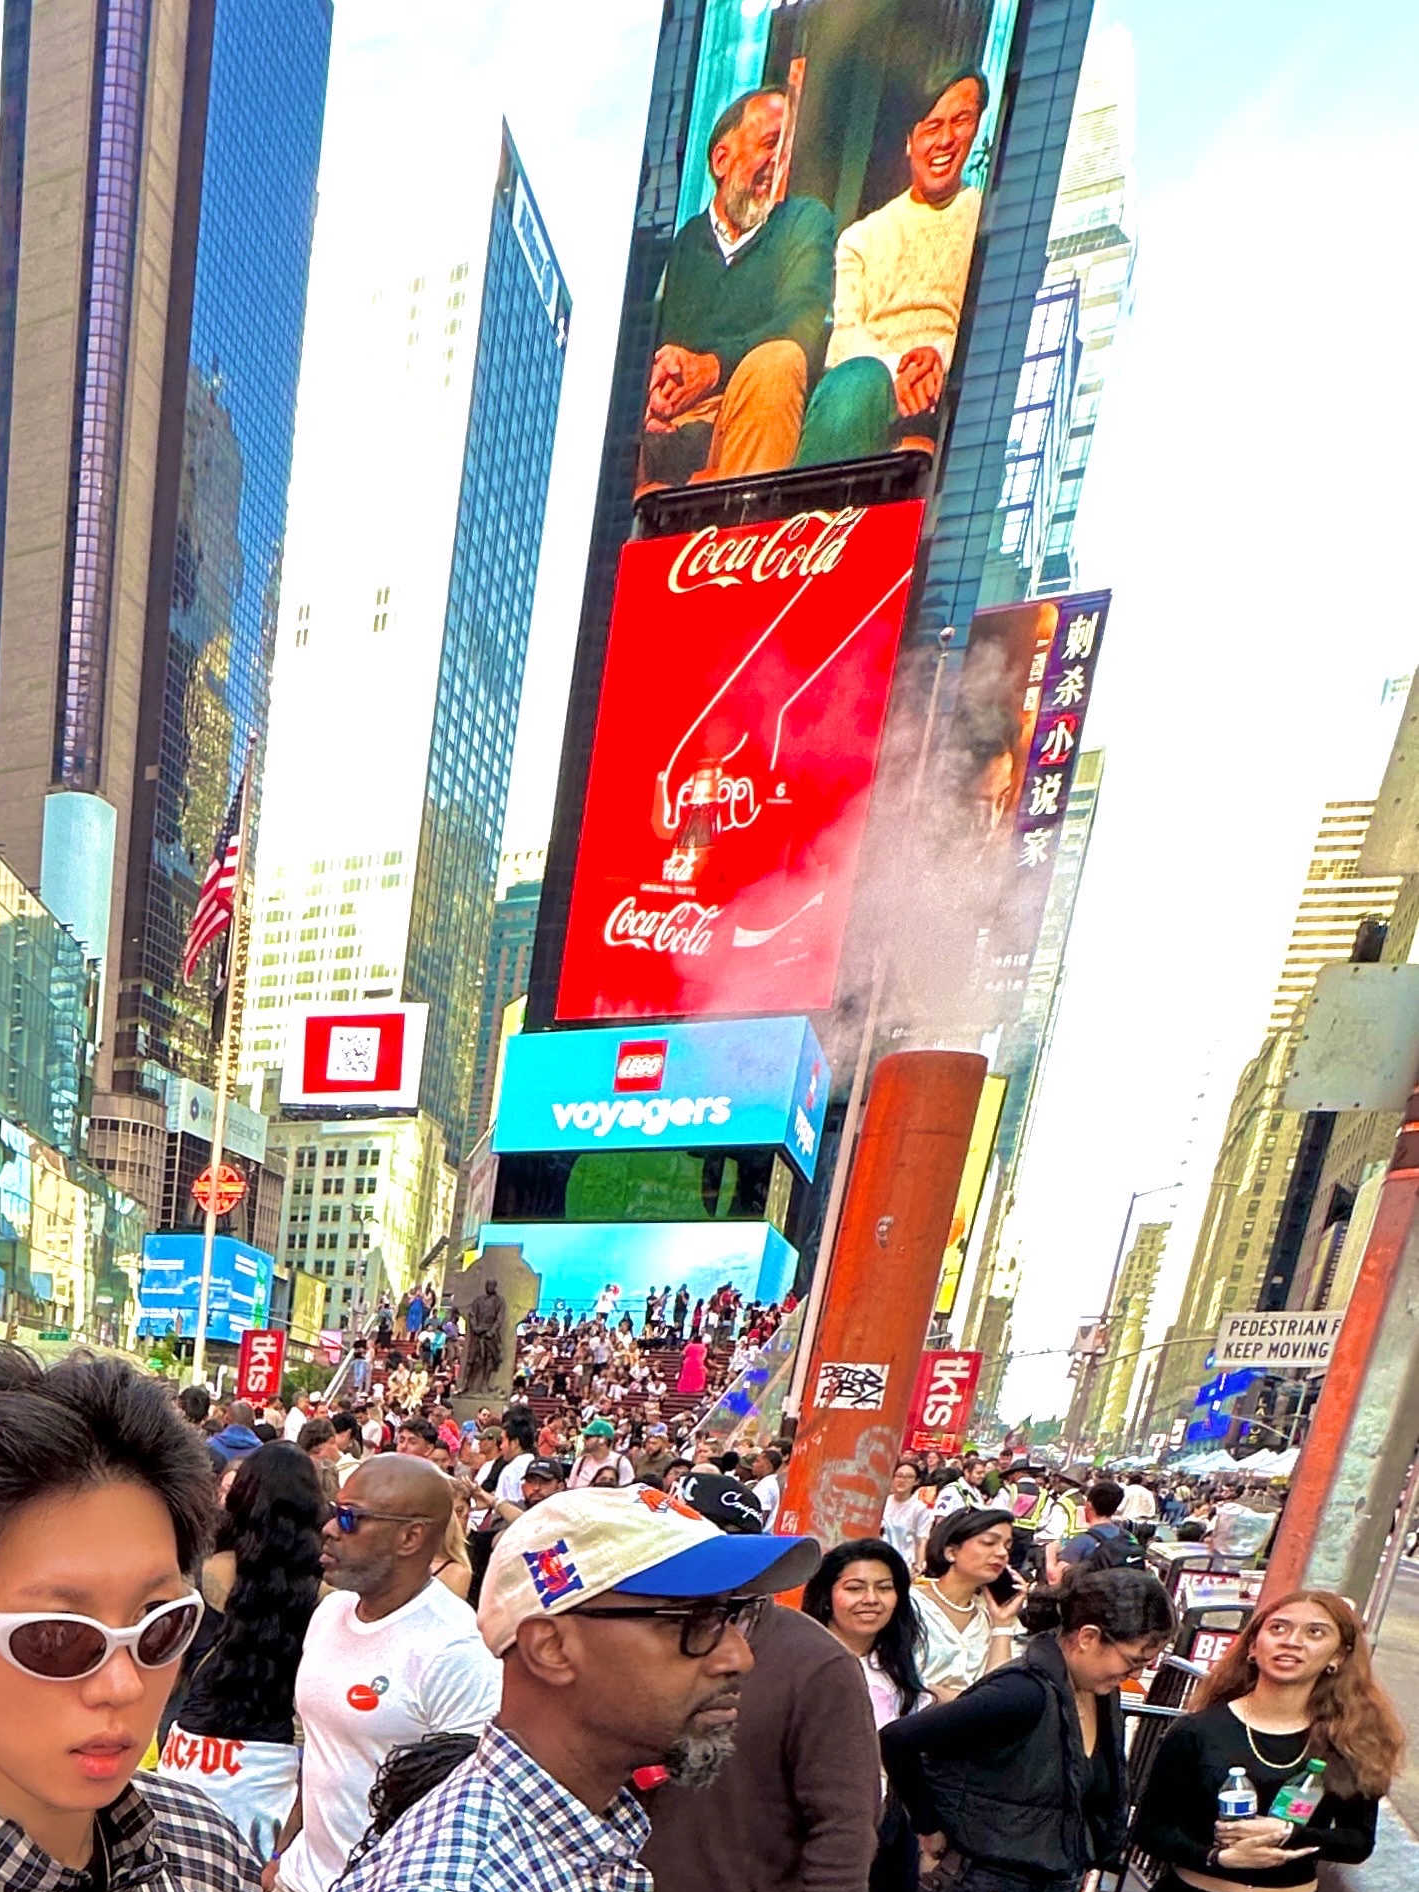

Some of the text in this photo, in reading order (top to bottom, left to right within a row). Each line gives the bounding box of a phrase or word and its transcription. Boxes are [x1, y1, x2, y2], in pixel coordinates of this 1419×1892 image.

[668, 506, 868, 594] Coca-Cola
[1018, 612, 1099, 868] 刺杀小说家
[604, 896, 723, 956] Coca-Cola
[617, 1054, 663, 1078] LEGO
[552, 1096, 731, 1136] voyagers
[1222, 1341, 1330, 1359] KEEP MOVING
[1228, 1318, 1327, 1337] PEDESTRIAN
[247, 1333, 277, 1393] tkts
[923, 1356, 971, 1427] tkts
